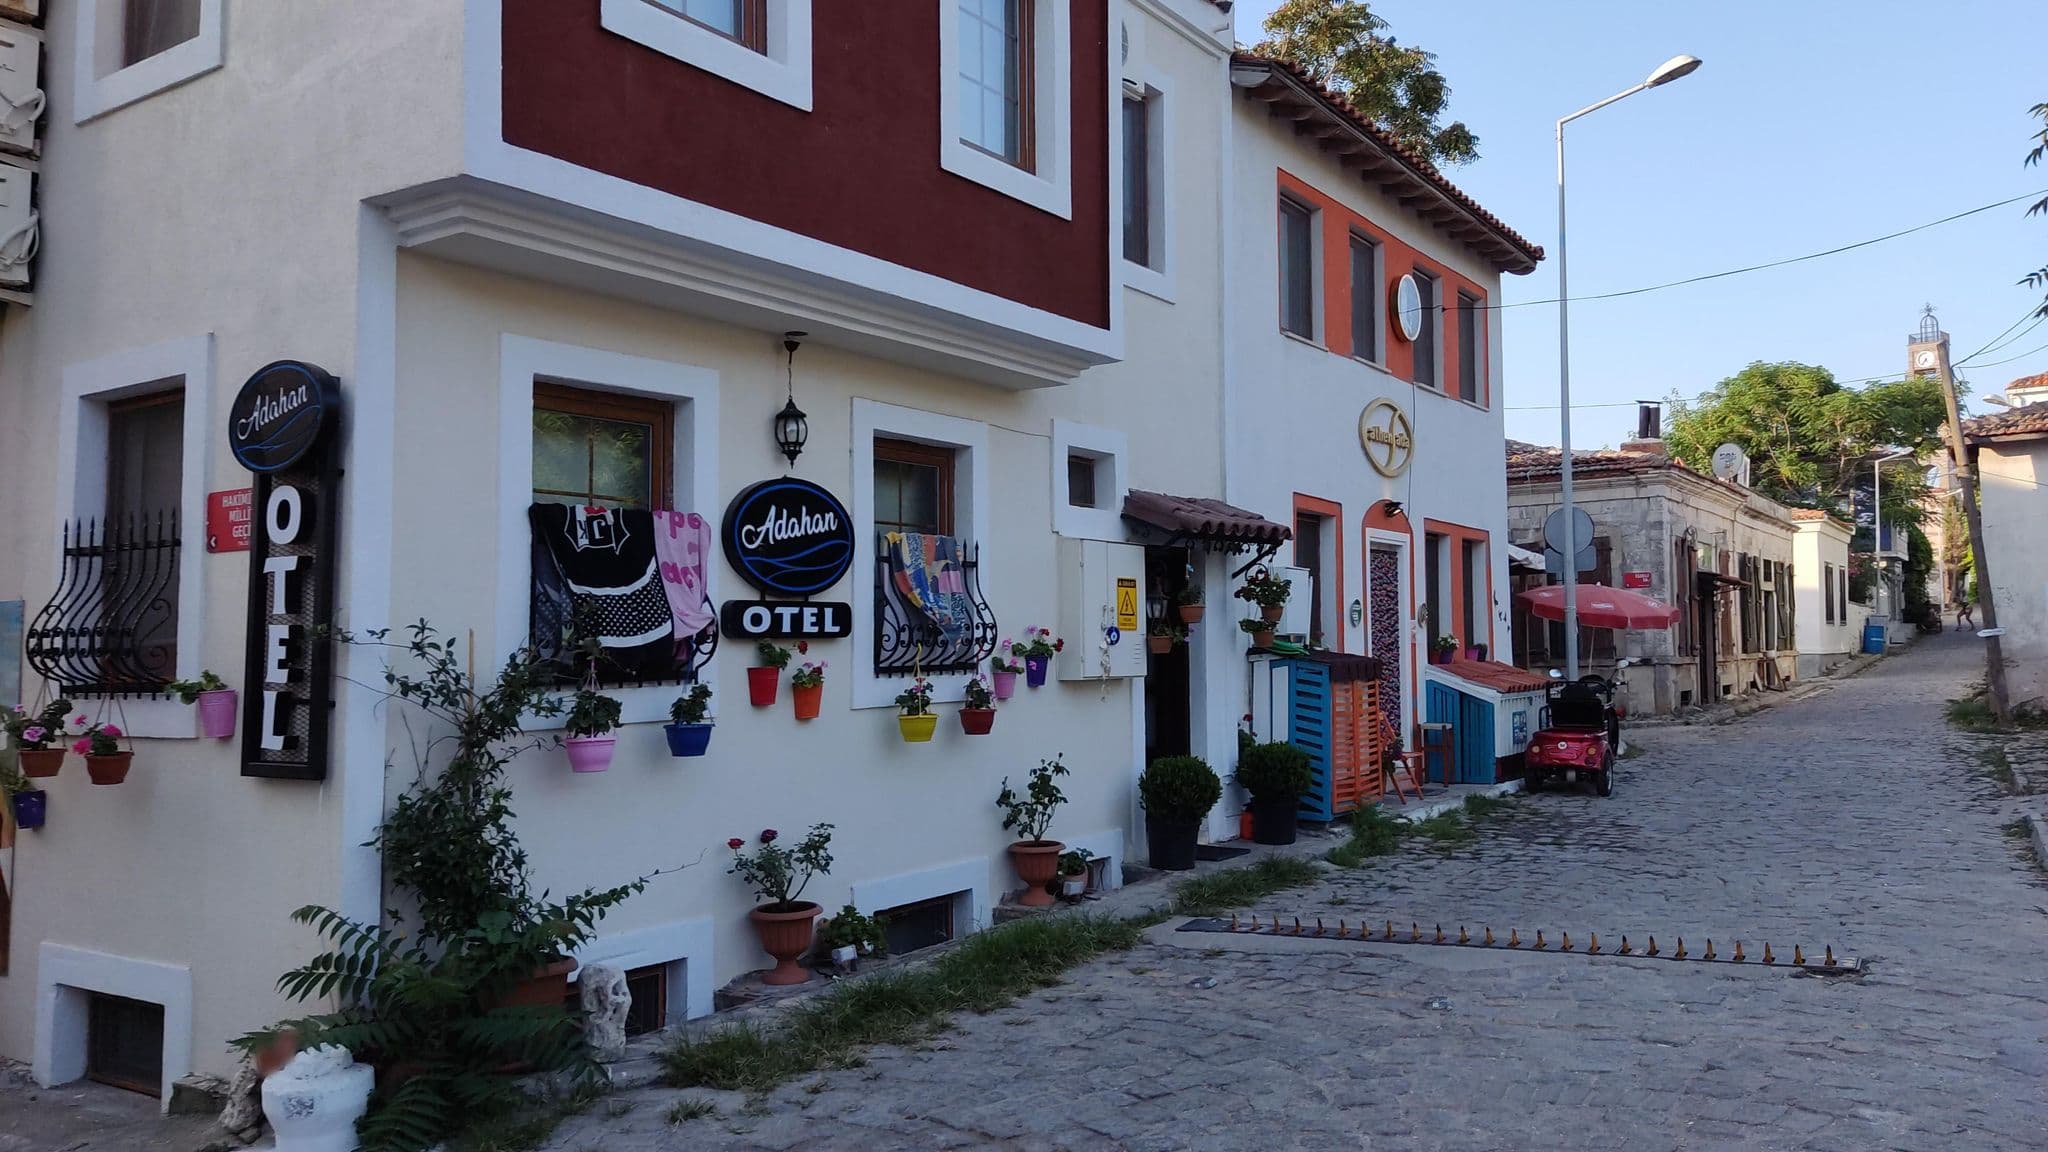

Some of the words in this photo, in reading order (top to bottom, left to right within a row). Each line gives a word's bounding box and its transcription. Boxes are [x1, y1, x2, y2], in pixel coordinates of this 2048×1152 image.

[237, 384, 308, 440] Adahan
[222, 490, 252, 508] HAKİMİ
[229, 506, 252, 523] MİLLİ
[741, 505, 838, 549] Adahan
[232, 522, 252, 540] GEÇİ
[260, 485, 302, 751] OTEL
[742, 605, 841, 634] OTEL
